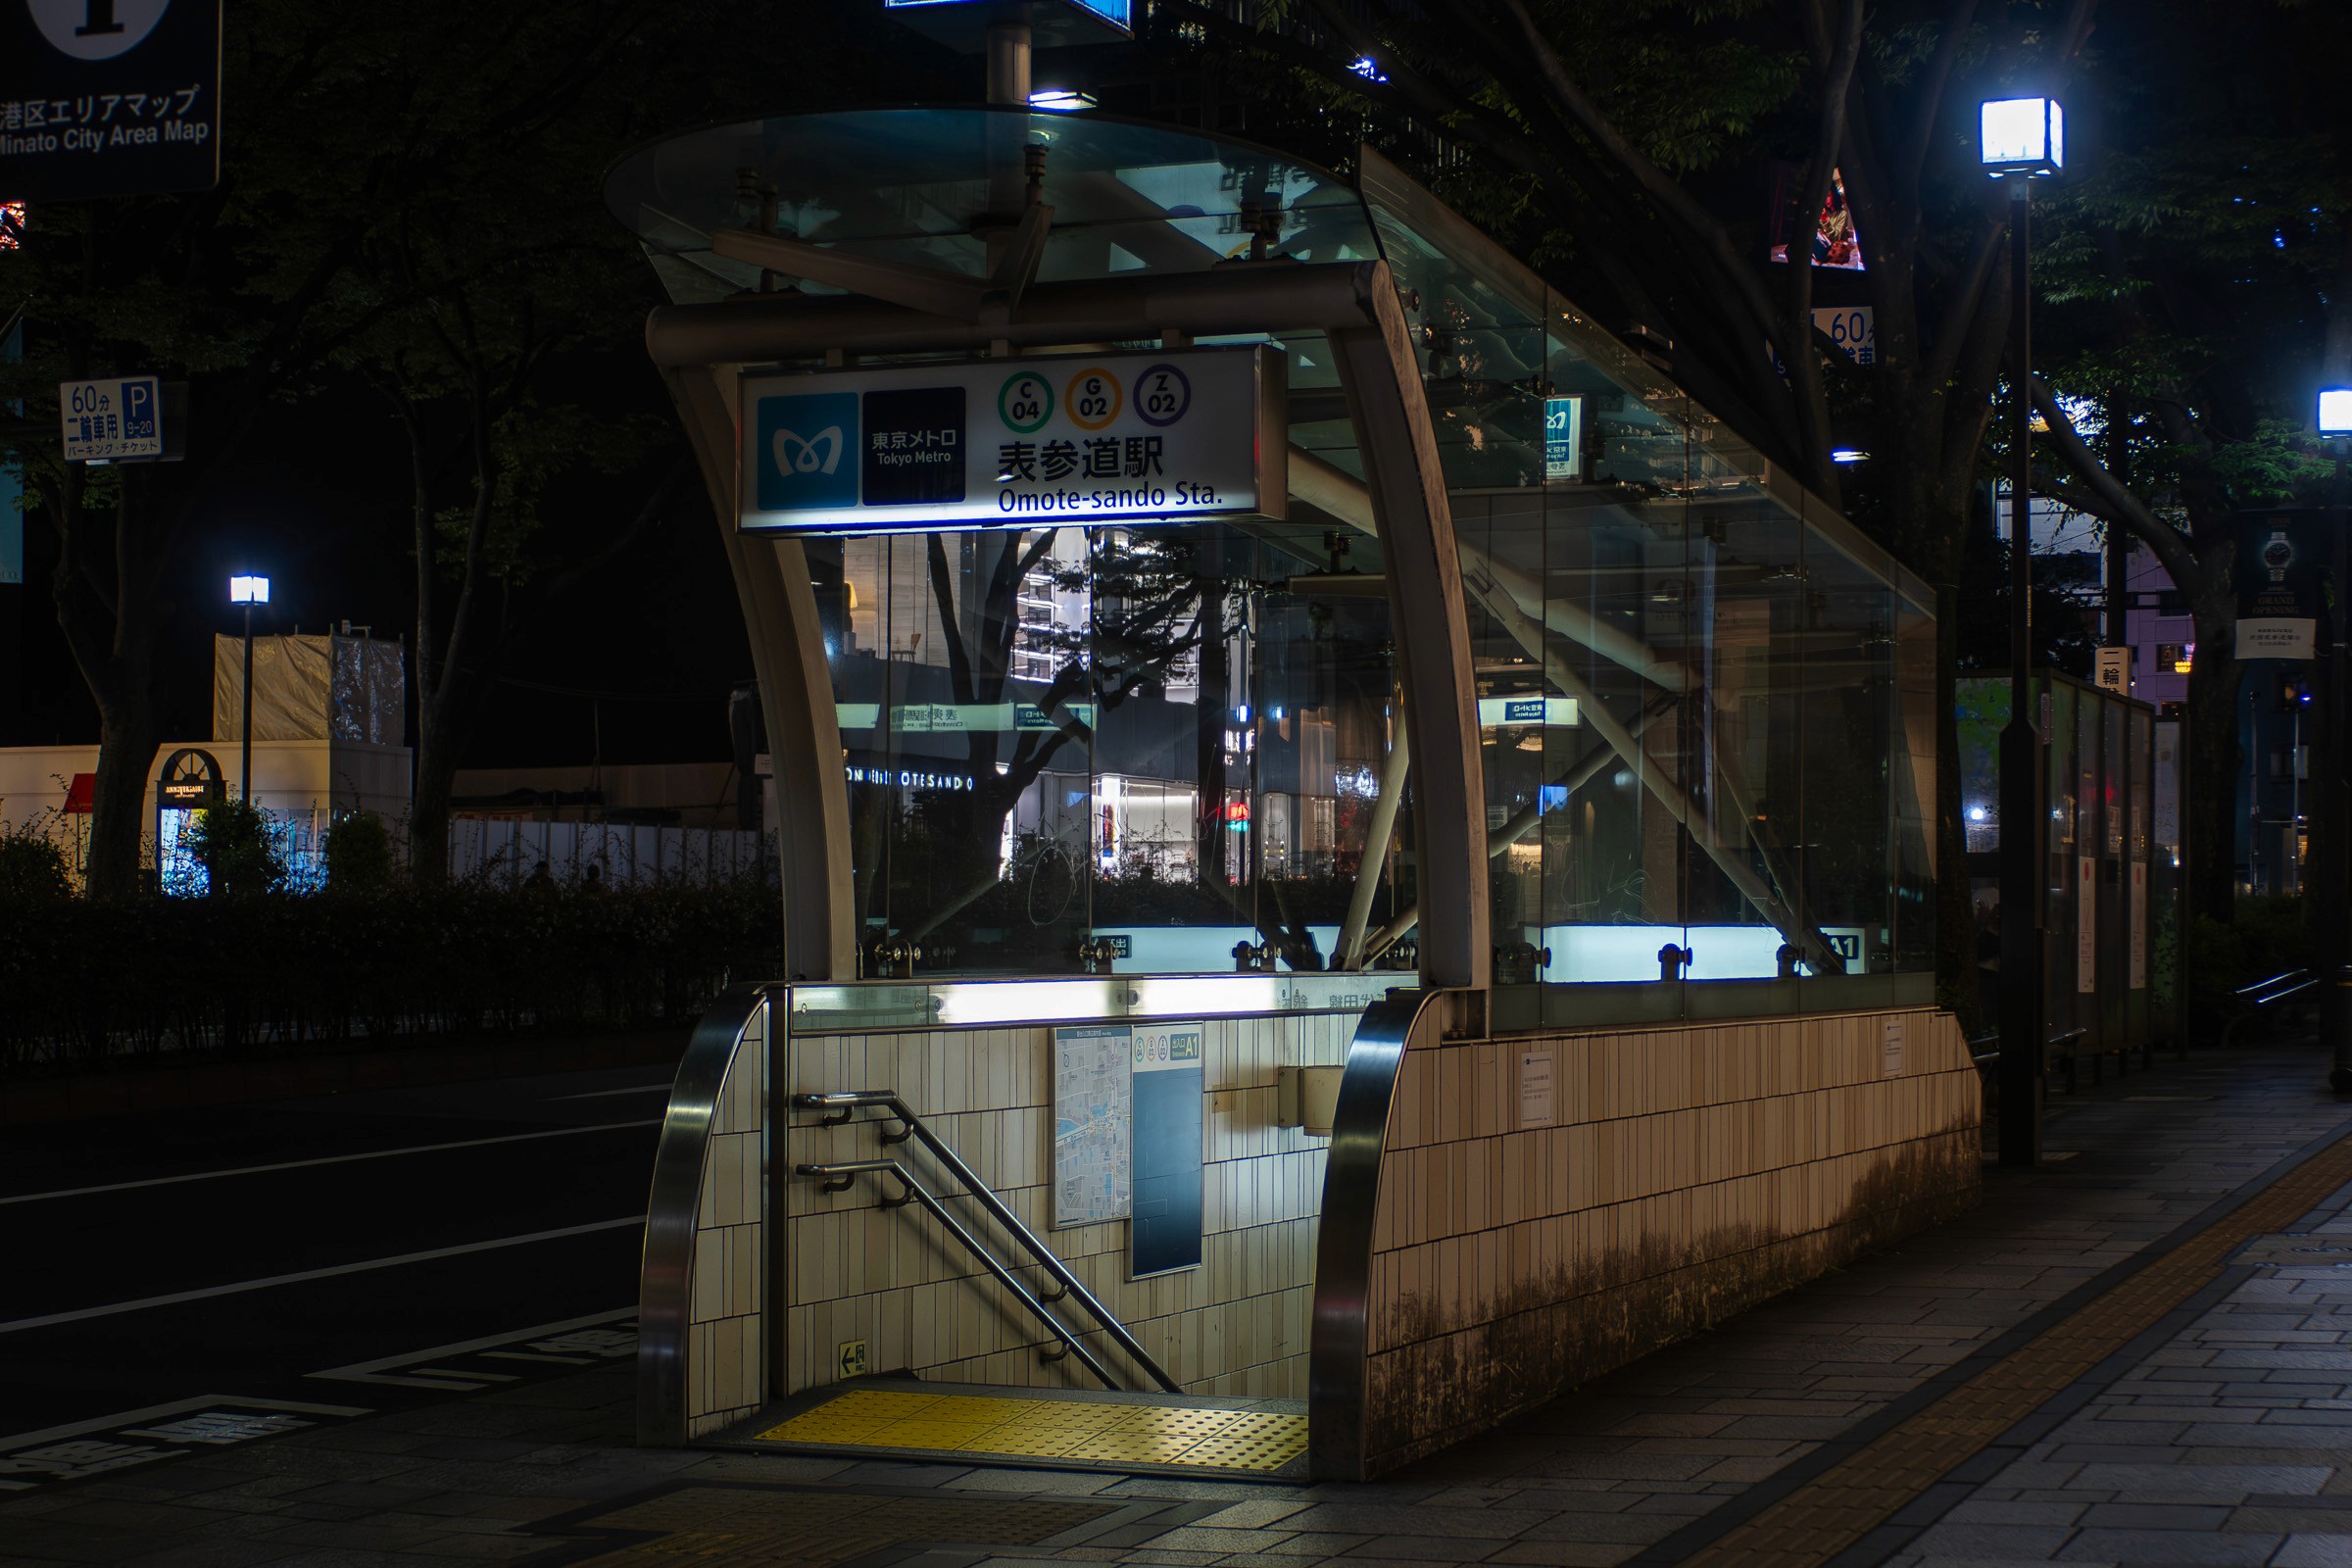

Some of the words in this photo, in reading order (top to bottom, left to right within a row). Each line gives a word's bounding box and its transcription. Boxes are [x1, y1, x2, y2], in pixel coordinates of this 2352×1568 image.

[0, 82, 202, 131] 港区エリアマップ
[0, 132, 58, 155] inato
[64, 127, 105, 153] City
[110, 123, 159, 146] Area
[164, 119, 210, 144] Map
[1019, 381, 1032, 399] C
[1086, 377, 1101, 395] G
[1155, 374, 1168, 392] Z
[72, 384, 110, 414] 60分
[129, 385, 148, 417] P
[1079, 397, 1107, 416] 02
[1148, 393, 1176, 414] 02
[1012, 400, 1040, 420] 04
[67, 414, 119, 443] 二輪車用
[126, 419, 153, 434] 9-20
[871, 429, 957, 450] 東京メトロ
[877, 452, 912, 466] Tokyo
[914, 450, 952, 464] Metro
[998, 435, 1164, 483] 表参道駅
[998, 481, 1165, 513] Omote-sando
[1175, 480, 1223, 506] Sta.
[2102, 651, 2120, 692] 二輪
[1185, 1036, 1198, 1056] A1
